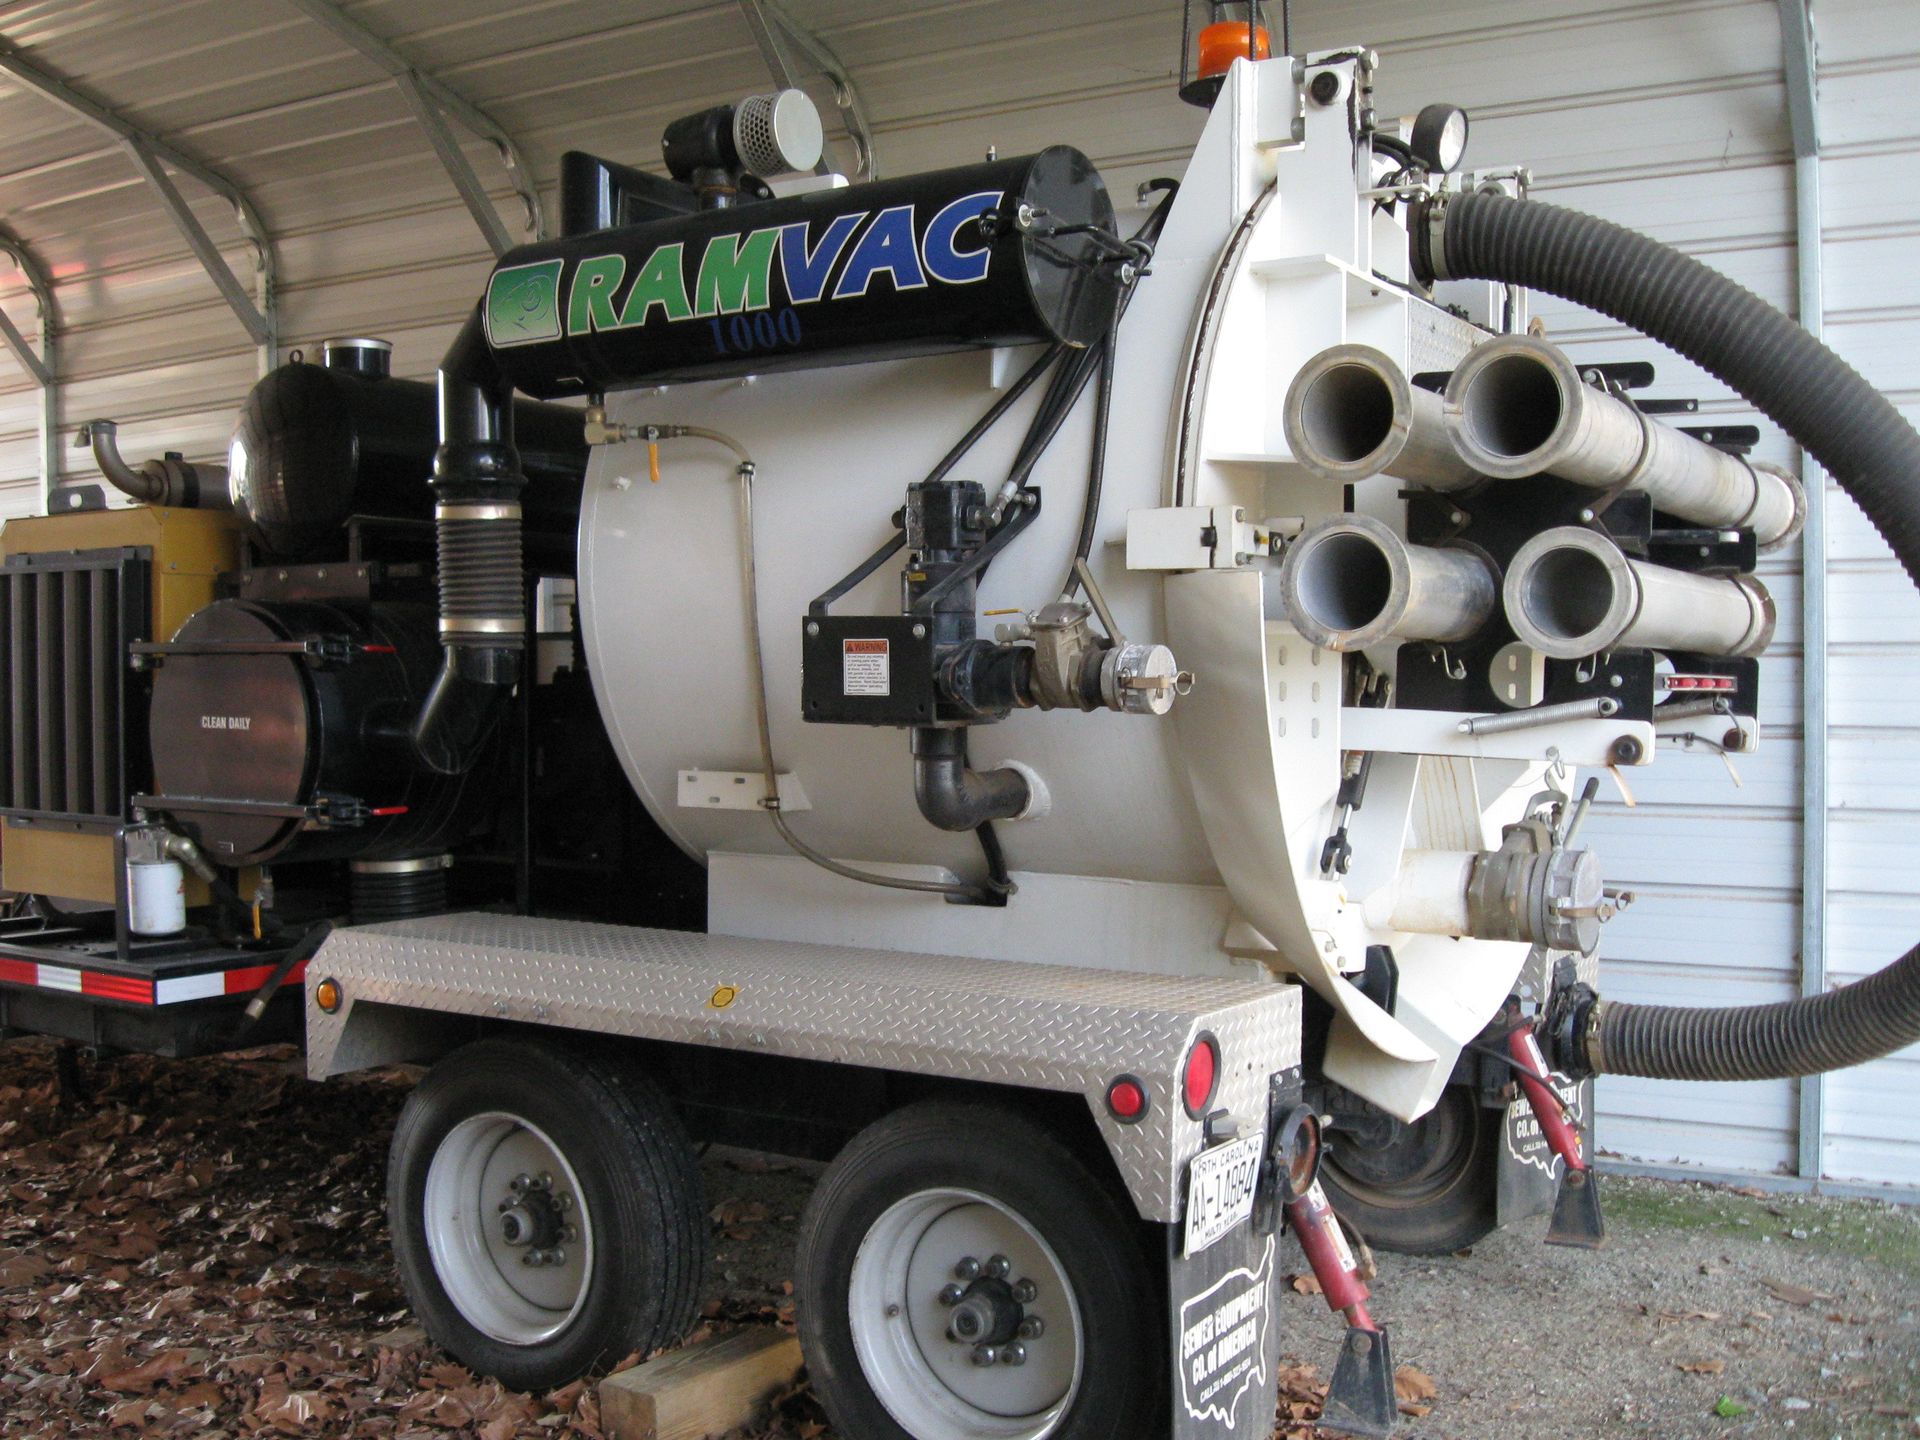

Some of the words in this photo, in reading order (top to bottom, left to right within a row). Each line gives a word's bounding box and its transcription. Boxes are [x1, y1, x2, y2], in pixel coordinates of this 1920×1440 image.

[568, 190, 1005, 337] RAMVAC
[708, 307, 801, 353] 1000
[854, 642, 887, 652] WARNING
[201, 715, 227, 729] CLEAN
[228, 716, 251, 730] DAILY
[1220, 1139, 1260, 1167] CAROLINA
[1184, 1313, 1215, 1360] SEWER
[1215, 1280, 1265, 1338] EQUIPMENT
[1192, 1353, 1208, 1386] CO.
[1207, 1343, 1217, 1374] of
[1218, 1316, 1257, 1368] AMERICA
